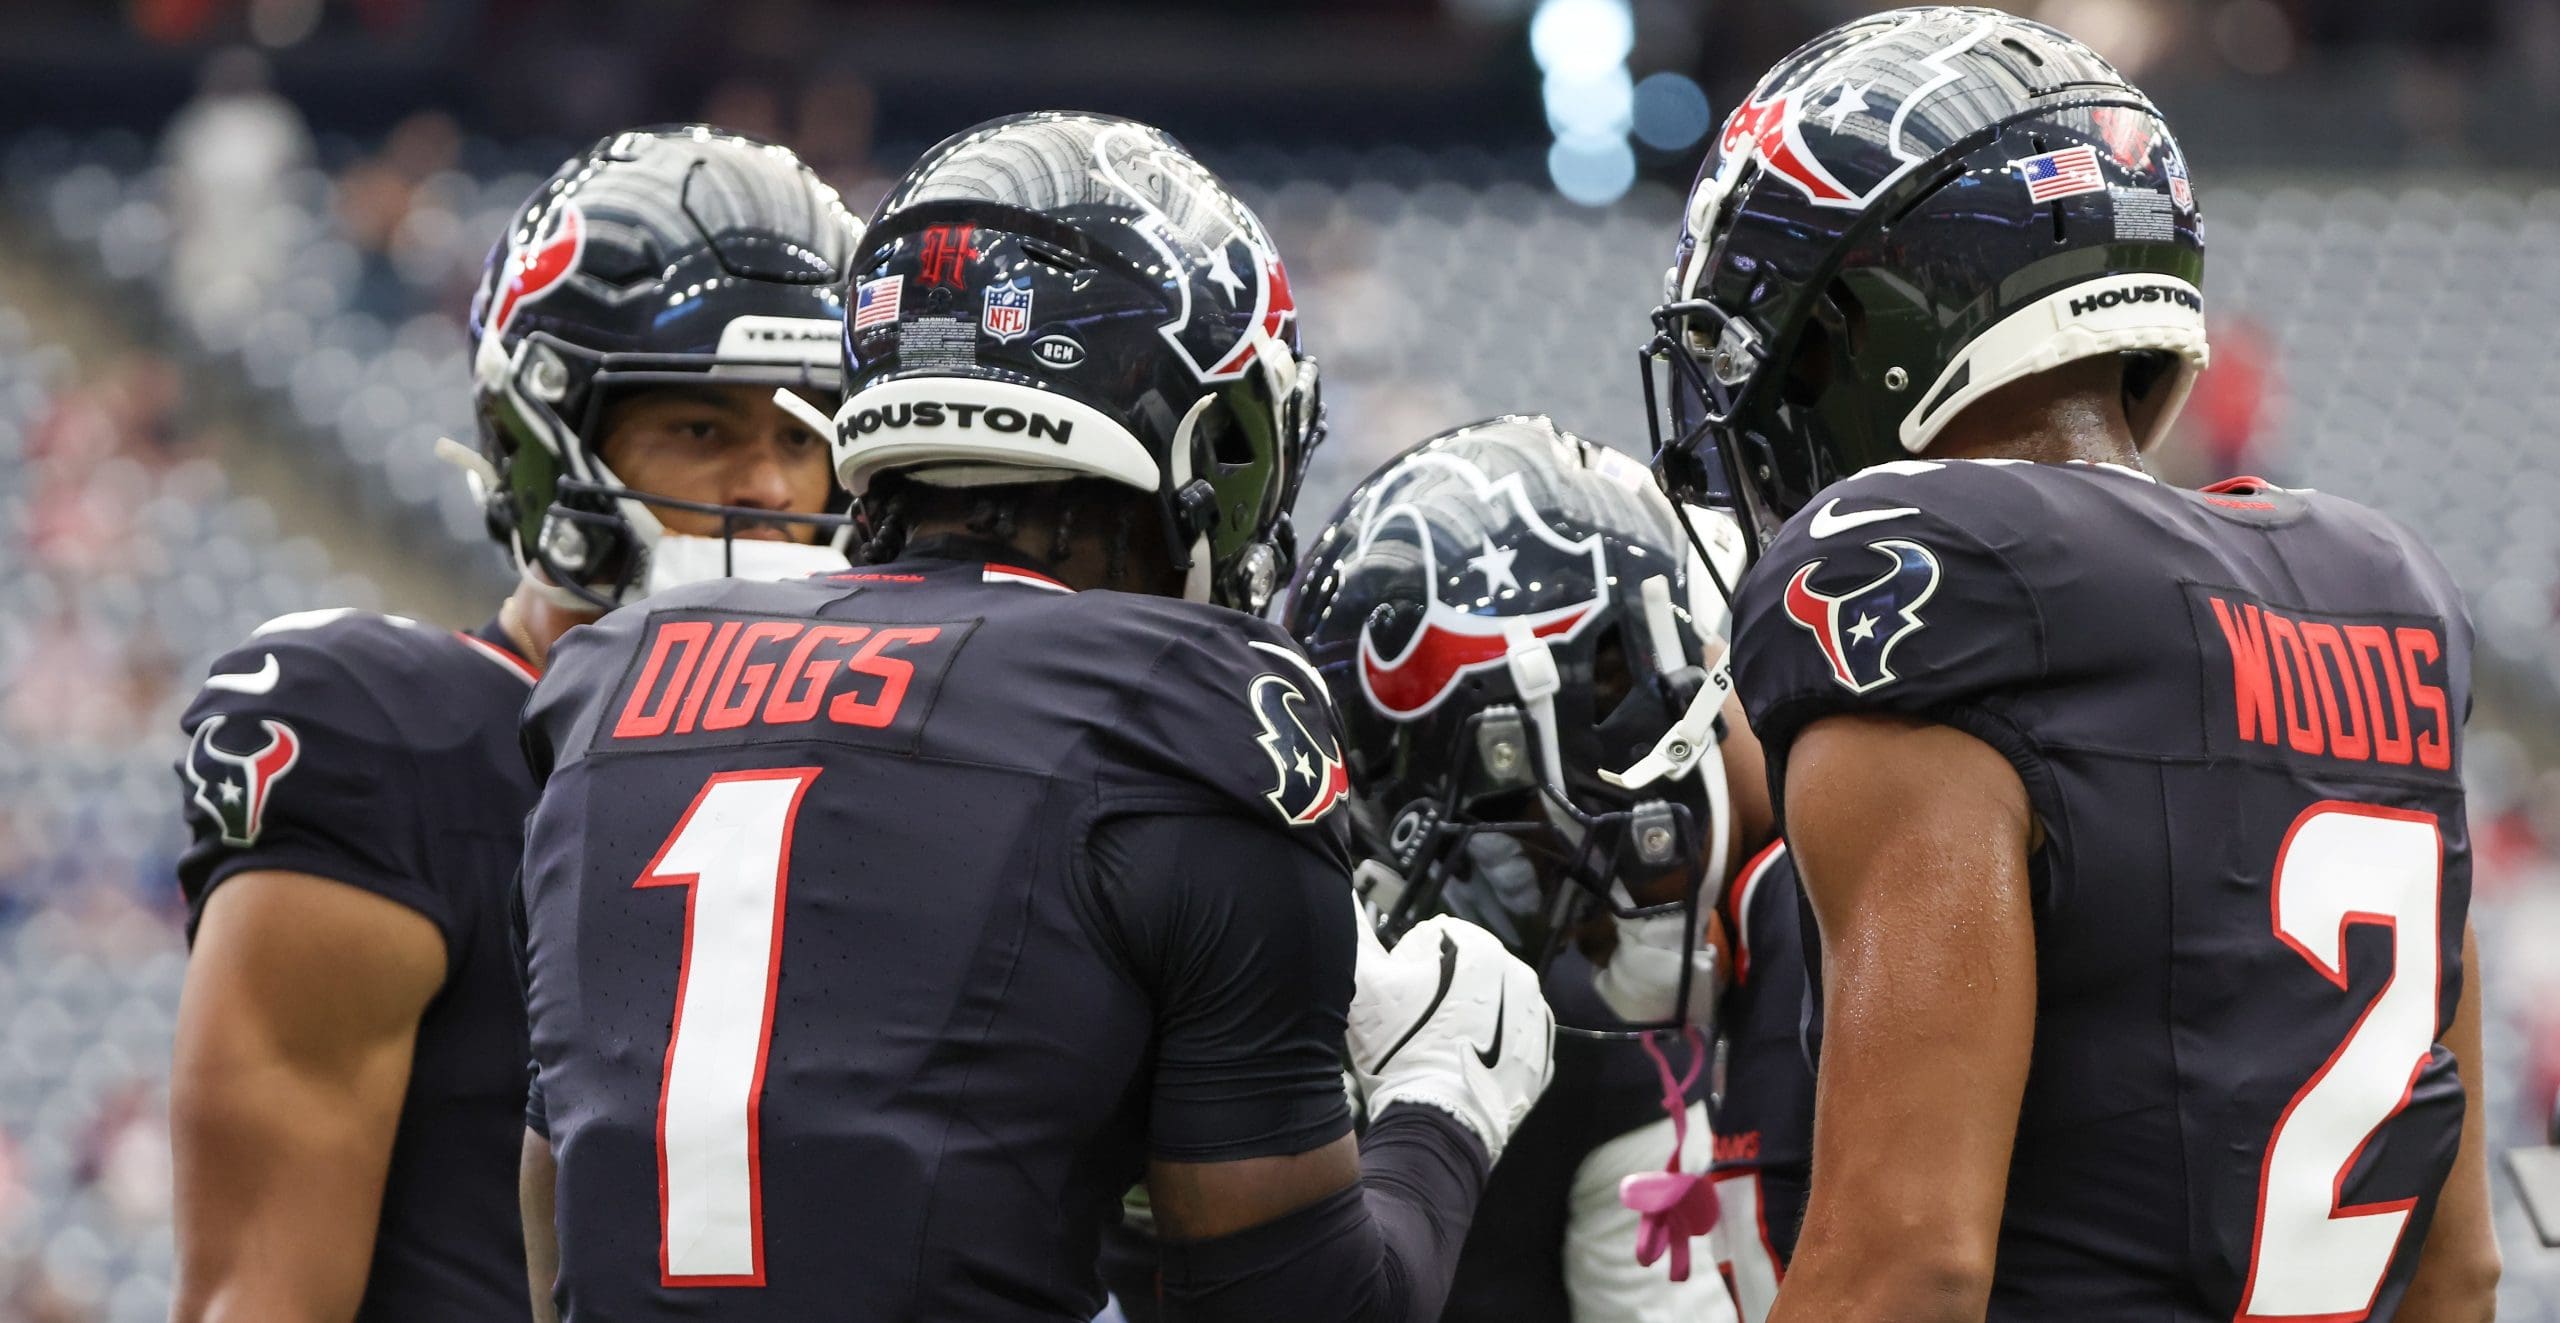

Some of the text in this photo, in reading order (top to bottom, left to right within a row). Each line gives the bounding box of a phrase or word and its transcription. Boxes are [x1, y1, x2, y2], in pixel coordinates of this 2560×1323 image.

[989, 307, 1023, 332] NFL
[1043, 342, 1074, 361] RCM
[836, 401, 1073, 447] HOUSTON
[612, 622, 940, 738] DIGGS
[2209, 597, 2450, 770] WOODS
[632, 767, 824, 1287] 1
[2234, 800, 2443, 1323] 2
